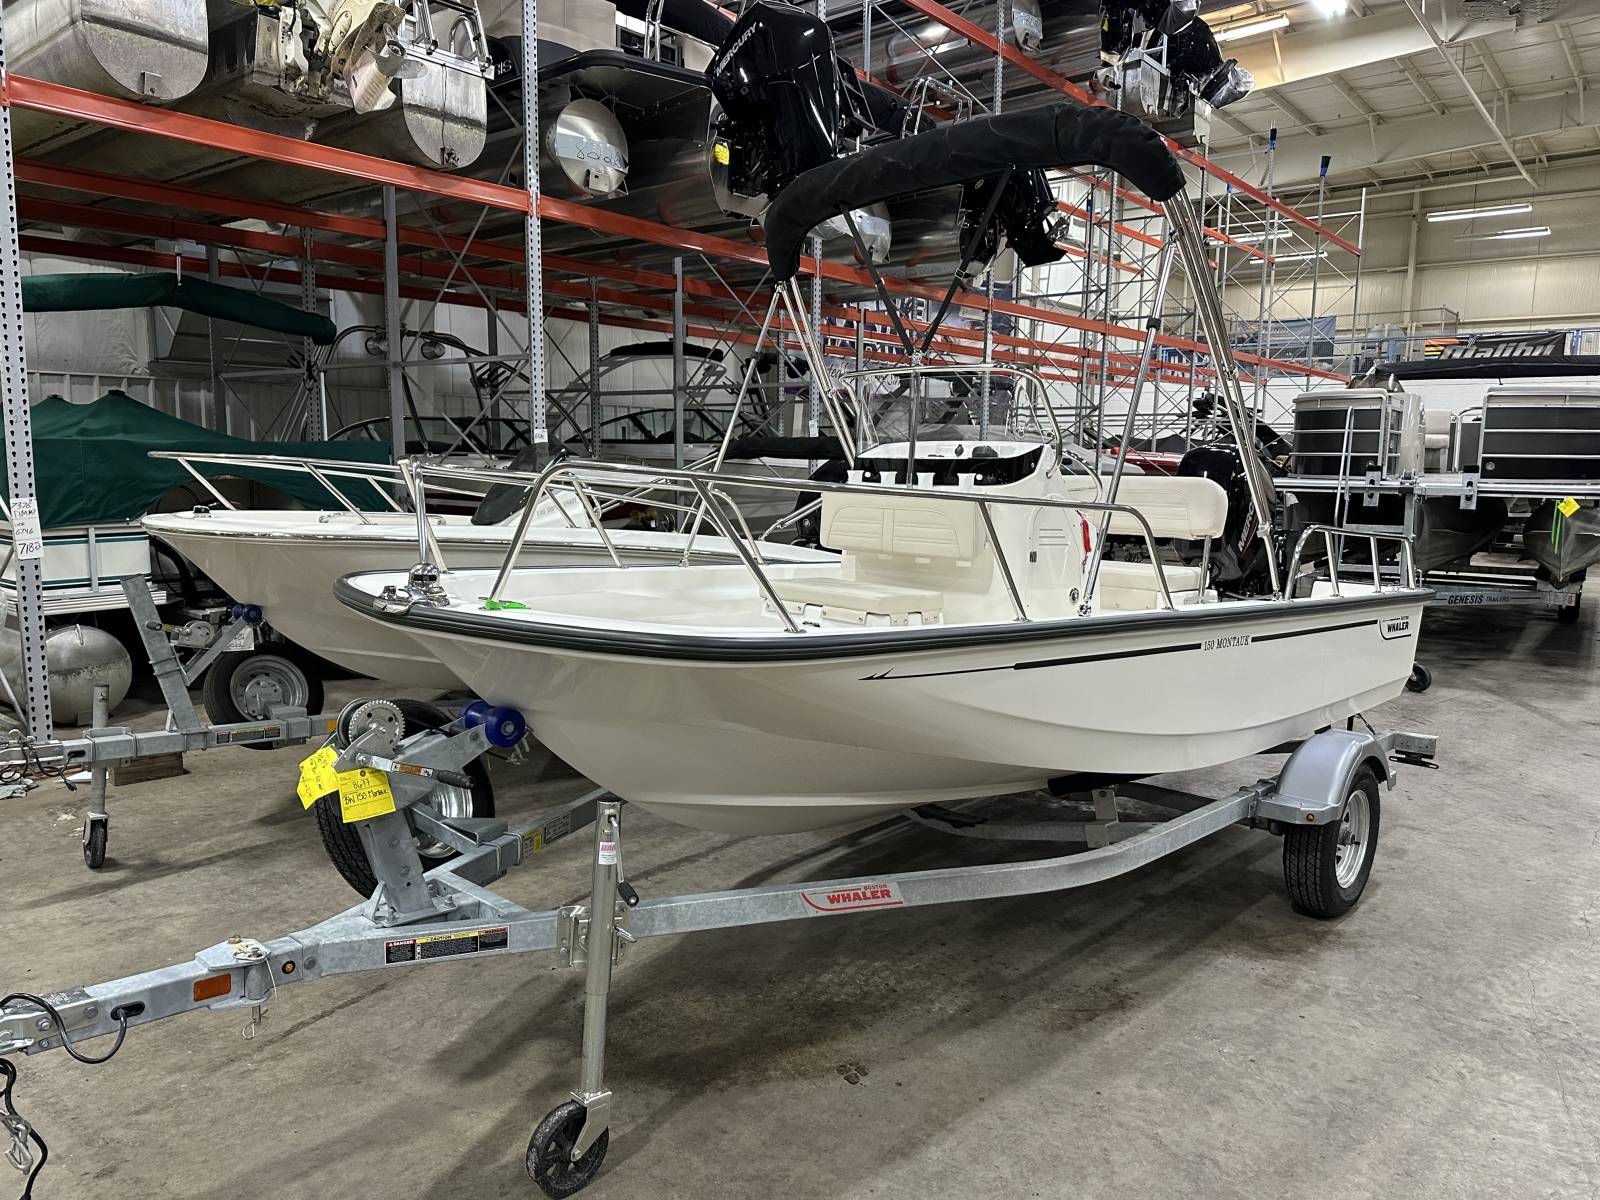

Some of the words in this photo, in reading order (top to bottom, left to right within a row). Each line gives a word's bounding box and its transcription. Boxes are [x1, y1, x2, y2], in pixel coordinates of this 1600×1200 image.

[715, 22, 757, 77] MERCURY
[1238, 496, 1254, 552] MERC
[1447, 594, 1484, 605] GENESIS
[1387, 621, 1410, 633] WHALER
[1216, 635, 1250, 649] MONTAUK
[827, 889, 892, 904] WHALER
